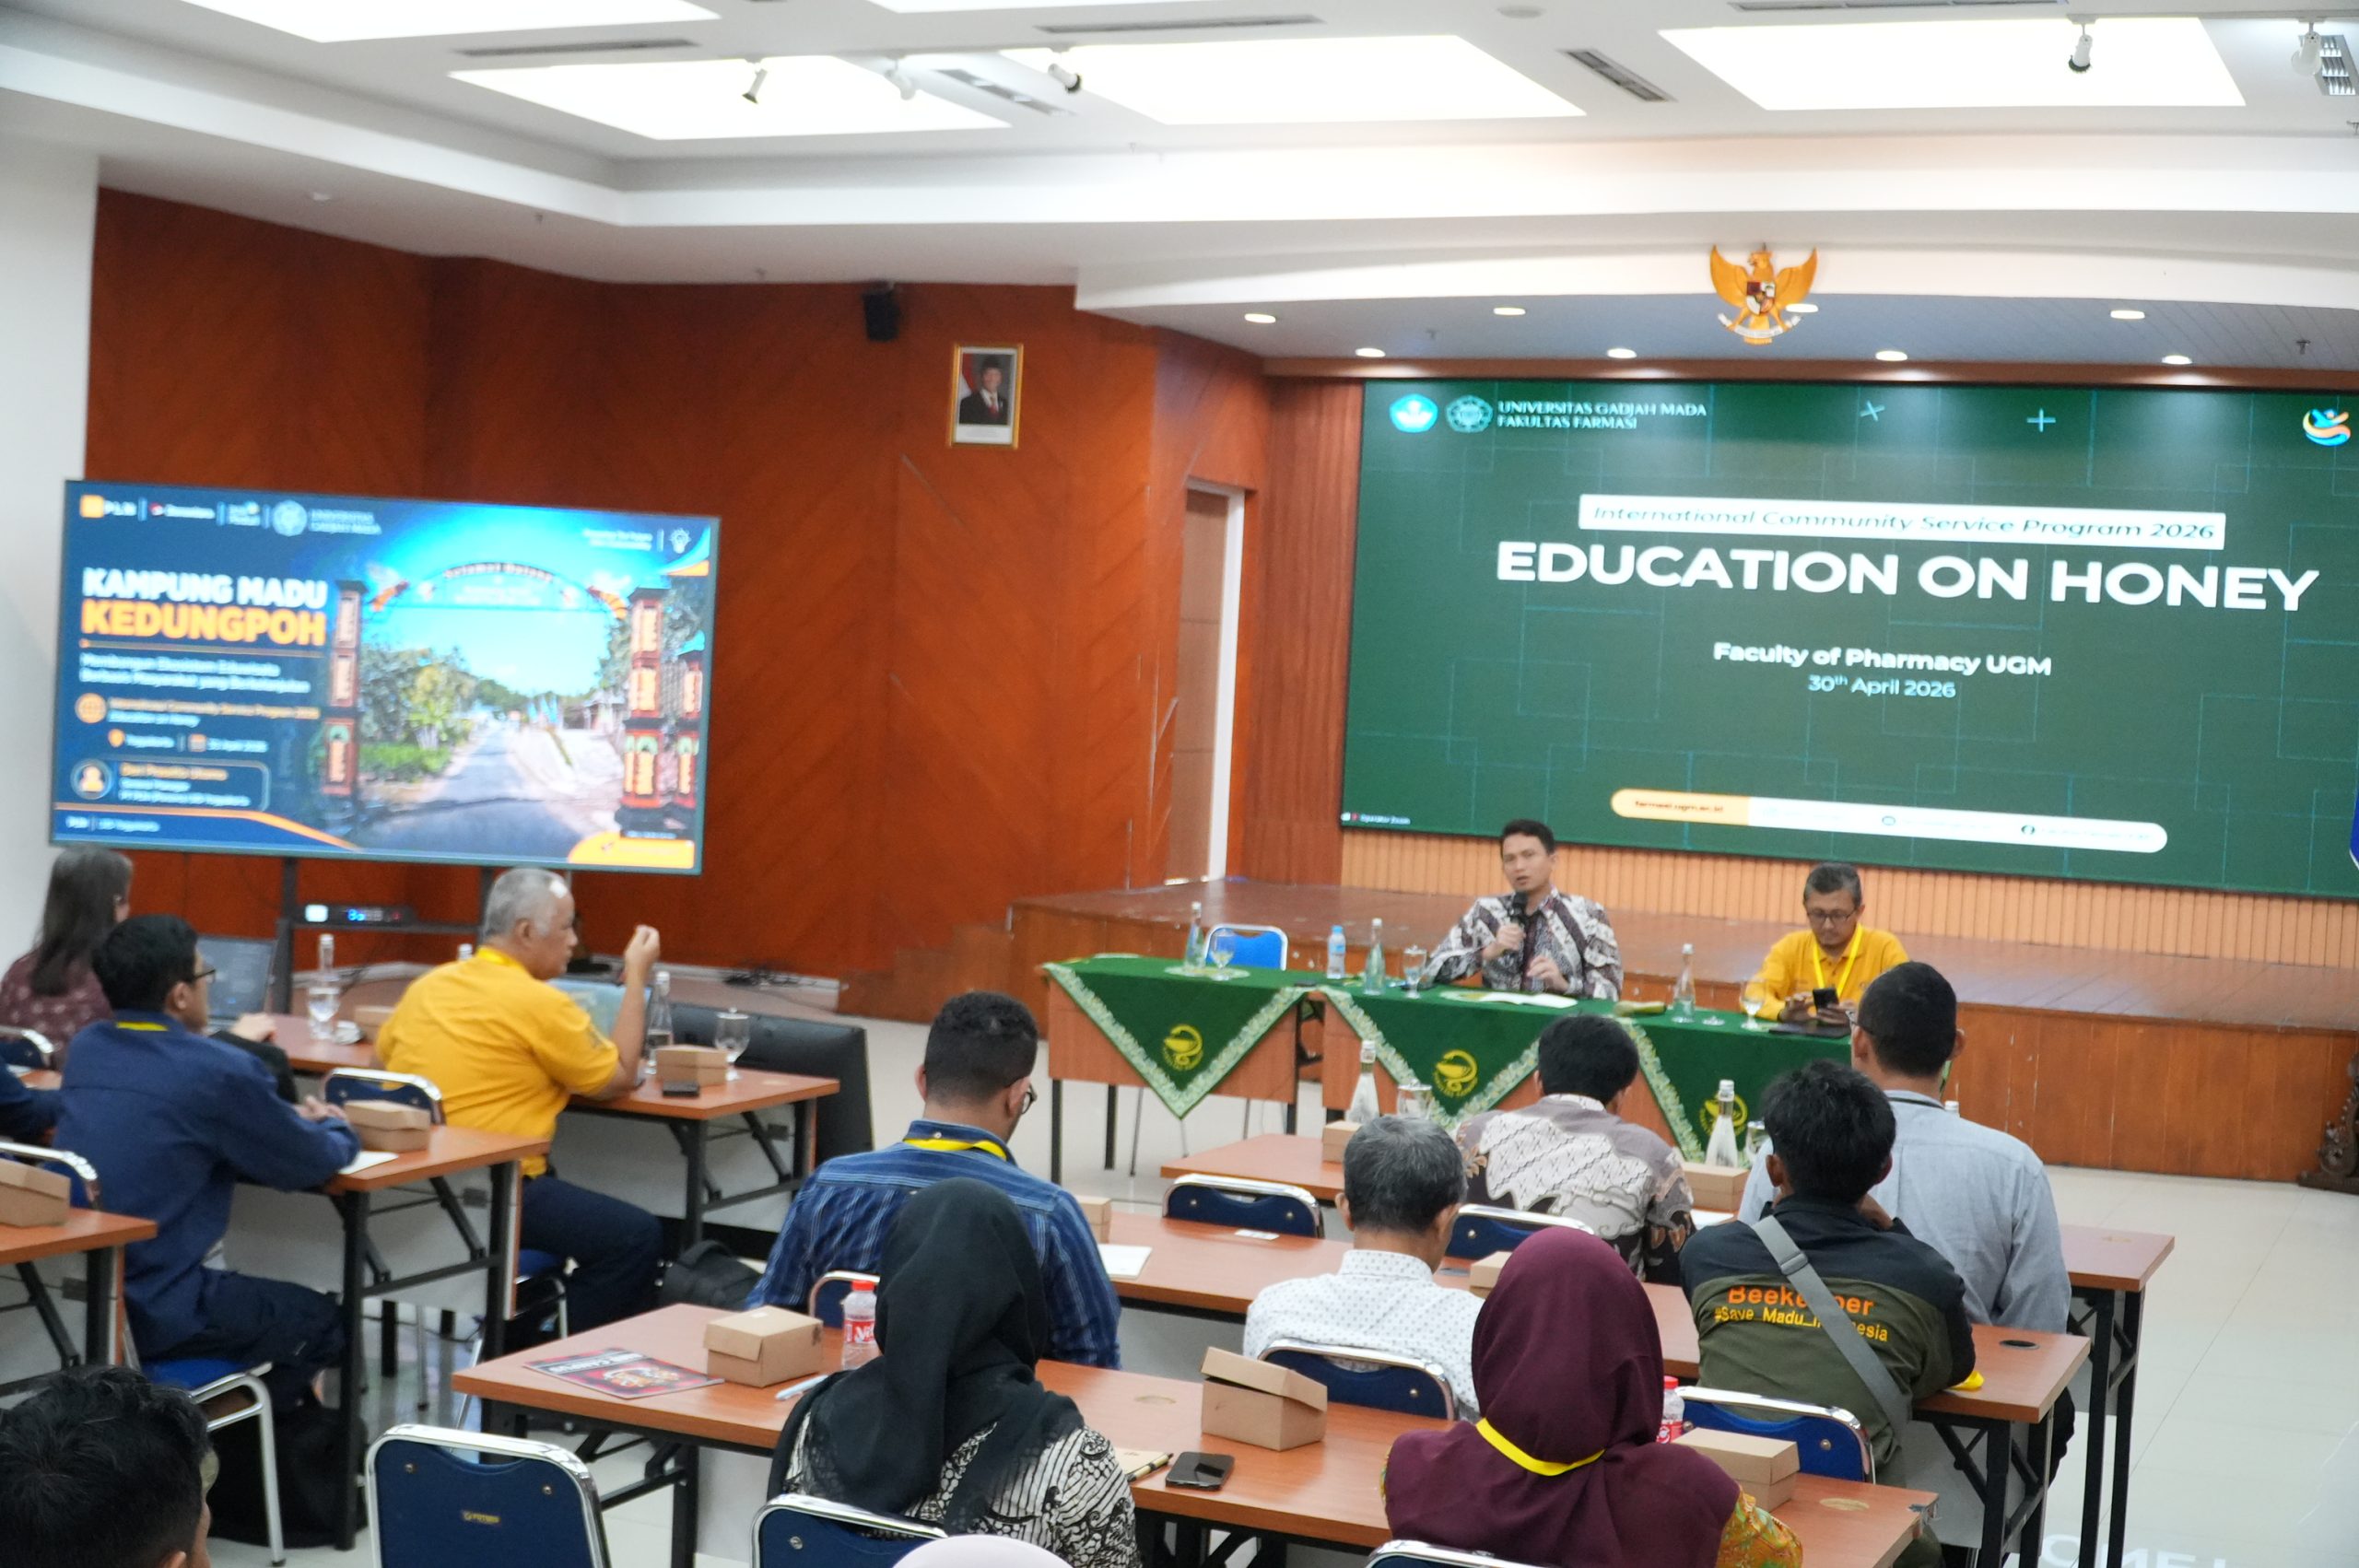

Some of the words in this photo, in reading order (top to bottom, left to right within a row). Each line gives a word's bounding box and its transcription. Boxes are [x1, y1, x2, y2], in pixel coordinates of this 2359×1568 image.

[1496, 415, 1570, 428] FAKULTAS
[1573, 416, 1637, 429] FARMASI
[1497, 401, 1592, 415] UNIVERSITAS
[1595, 403, 1657, 418] GADJAH
[1660, 403, 1707, 416] MADA
[1593, 507, 1755, 524] International
[1762, 511, 1914, 532] Community
[1921, 516, 2014, 532] Service
[2023, 519, 2142, 539] Program
[2150, 523, 2214, 539] 2026
[82, 567, 234, 605] KAMPUNG
[236, 575, 328, 609] MADU
[1497, 541, 1898, 595] EDUCATION
[1918, 556, 2028, 600] ON
[2050, 560, 2319, 612] HONEY
[80, 598, 328, 646] KEDUNGPOH
[1713, 641, 1809, 668] Faculty
[1812, 646, 1842, 666] of
[1845, 648, 1981, 676] Pharmacy
[1986, 654, 2052, 676] UGM
[1850, 676, 1900, 697] April
[1903, 680, 1957, 698] 2026
